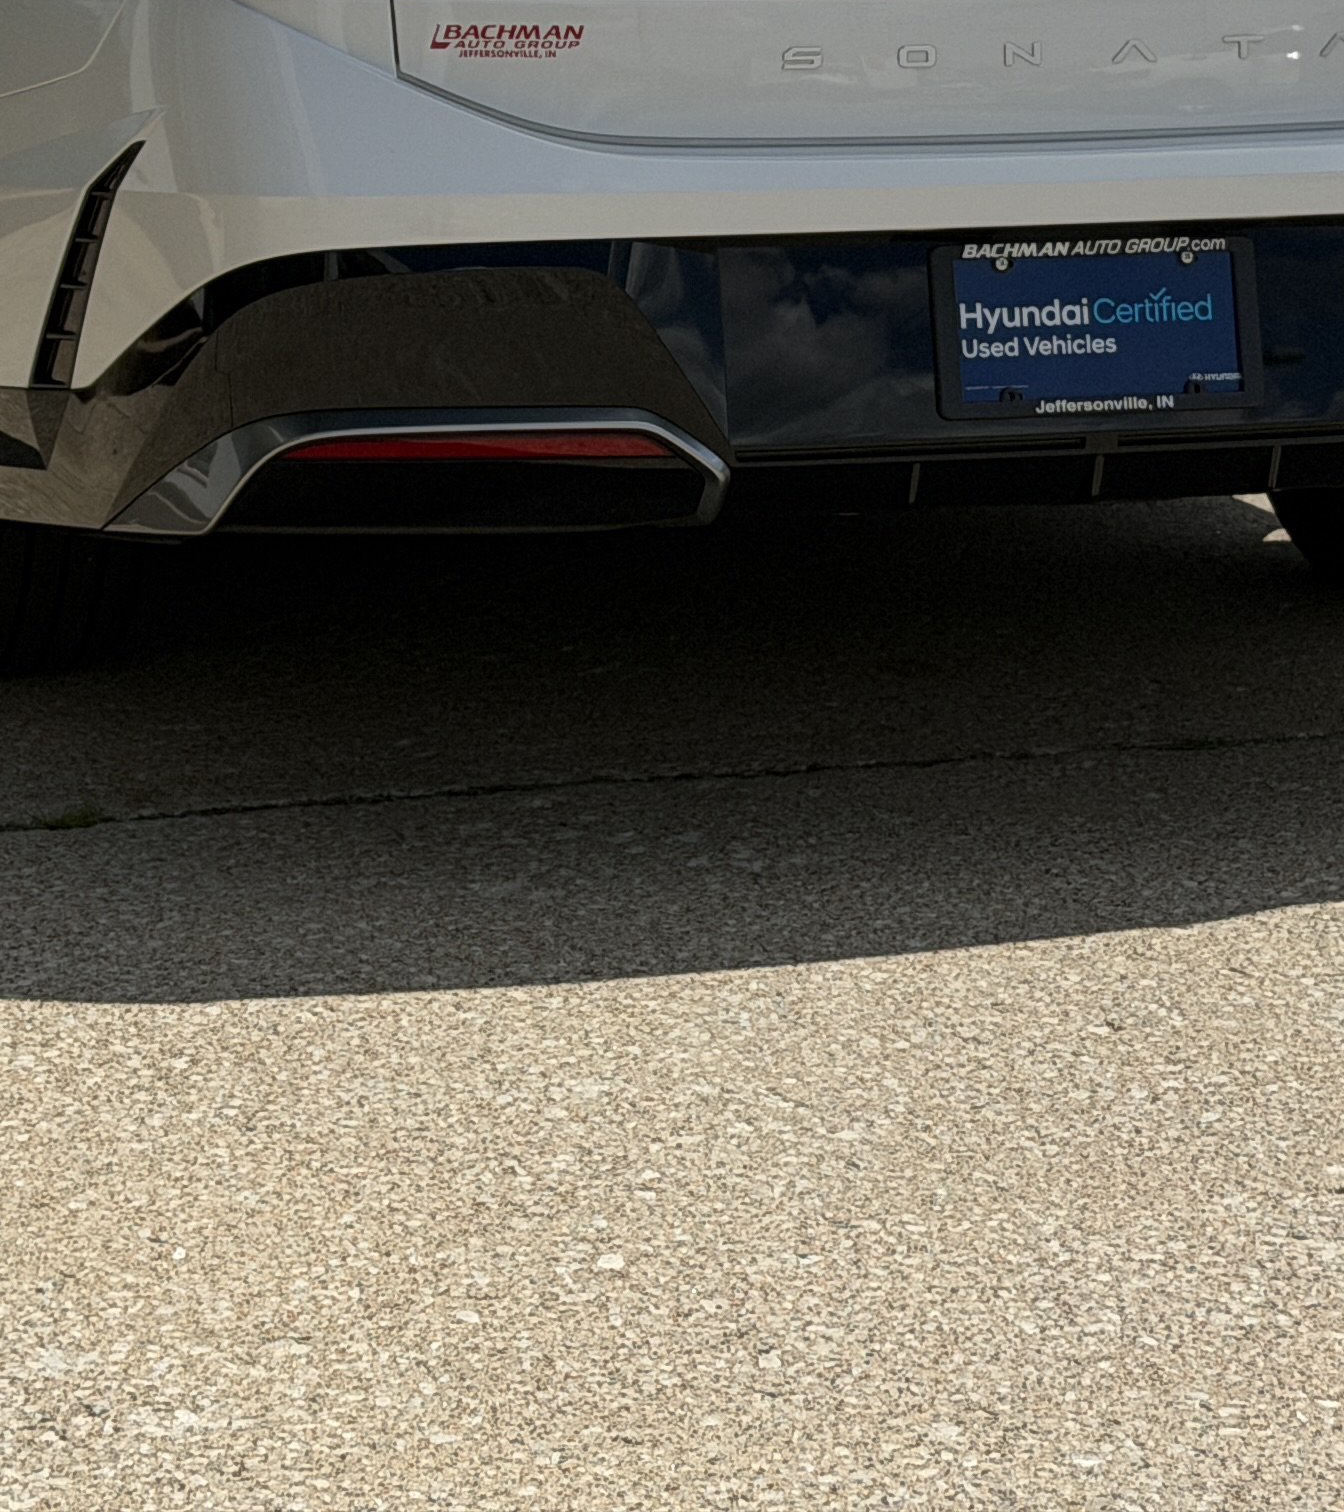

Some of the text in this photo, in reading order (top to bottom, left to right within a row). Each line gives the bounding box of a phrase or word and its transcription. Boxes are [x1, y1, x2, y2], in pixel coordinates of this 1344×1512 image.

[443, 24, 585, 40] BACHMAN
[454, 40, 581, 50] AUTO GROUP
[545, 50, 557, 58] IN
[962, 236, 1226, 259] BACHMAN AUTO GROUP.com
[959, 289, 1214, 334] Hyundai Certified
[961, 335, 1117, 359] Used Vehicles
[1035, 395, 1174, 414] Jeffersonville, IN
